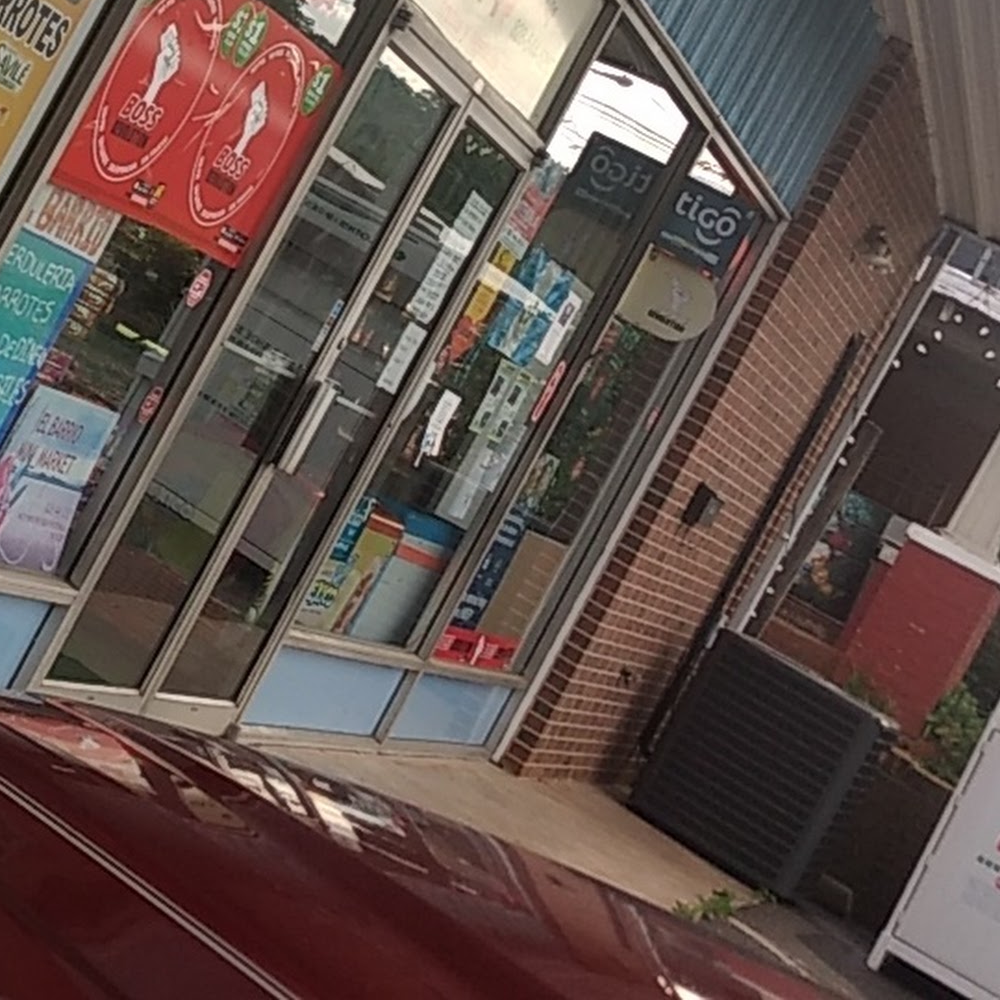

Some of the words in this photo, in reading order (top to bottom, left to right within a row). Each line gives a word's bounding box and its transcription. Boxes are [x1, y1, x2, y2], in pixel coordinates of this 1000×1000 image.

[119, 92, 164, 132] BOSS
[212, 144, 252, 181] BOSS
[3, 242, 76, 294] ERDULERIA
